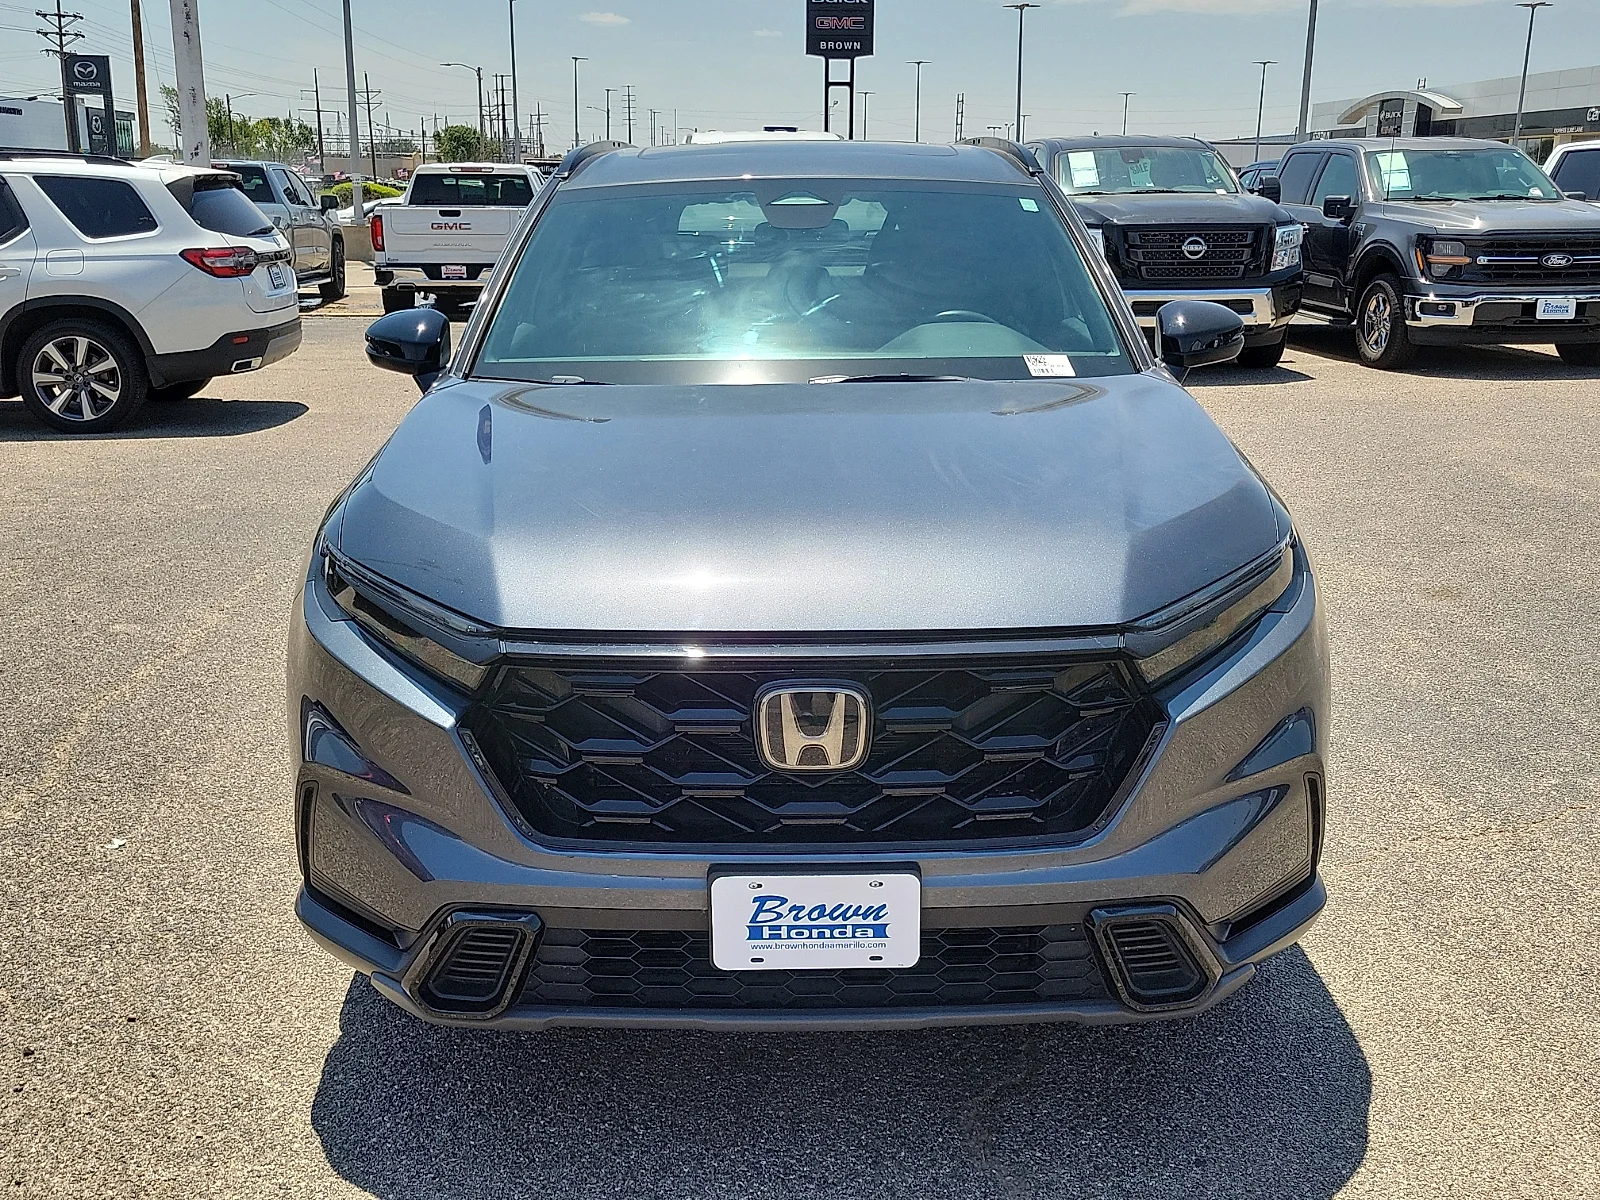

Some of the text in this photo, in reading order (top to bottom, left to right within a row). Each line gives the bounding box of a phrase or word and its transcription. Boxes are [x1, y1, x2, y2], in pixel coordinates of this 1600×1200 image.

[815, 16, 865, 30] GMC
[820, 41, 861, 50] BROWN
[1129, 161, 1149, 175] SALE
[431, 222, 472, 231] GMC
[1547, 254, 1568, 265] Ford
[748, 894, 889, 925] Brown
[762, 925, 875, 940] Honda
[750, 940, 887, 950] www.brownhondaamarillo.com
